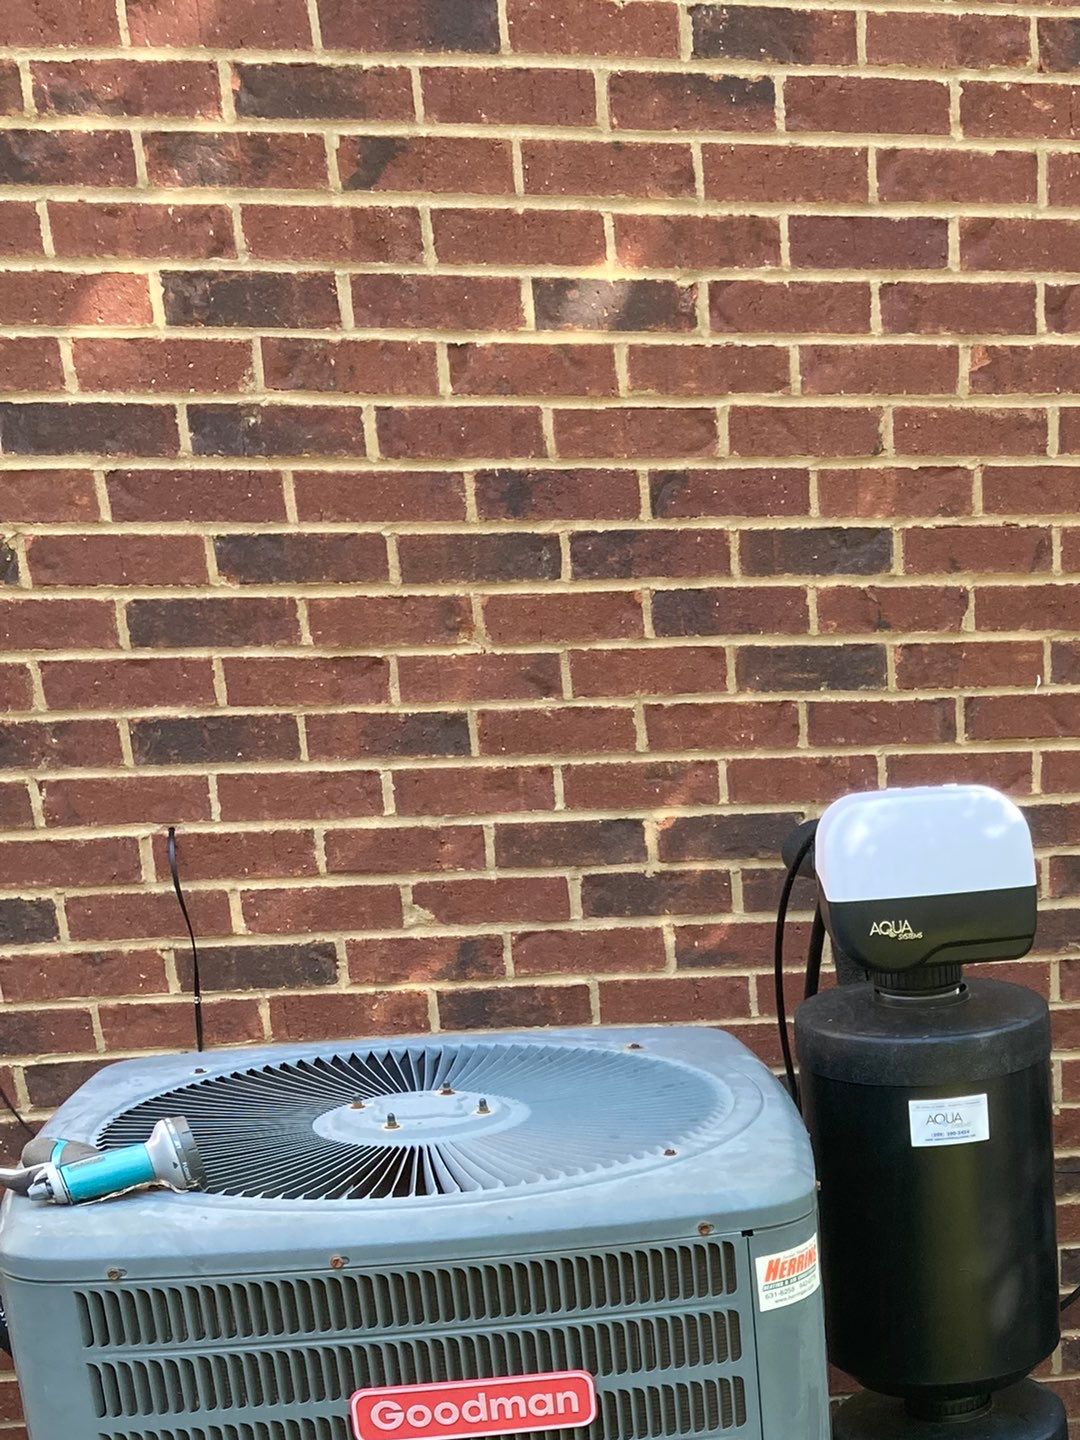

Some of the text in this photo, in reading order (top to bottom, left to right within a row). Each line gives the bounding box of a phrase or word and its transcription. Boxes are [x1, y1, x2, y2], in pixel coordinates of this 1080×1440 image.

[869, 919, 913, 937] AQUA
[926, 1112, 963, 1126] AQUA
[370, 1390, 580, 1431] Goodman
